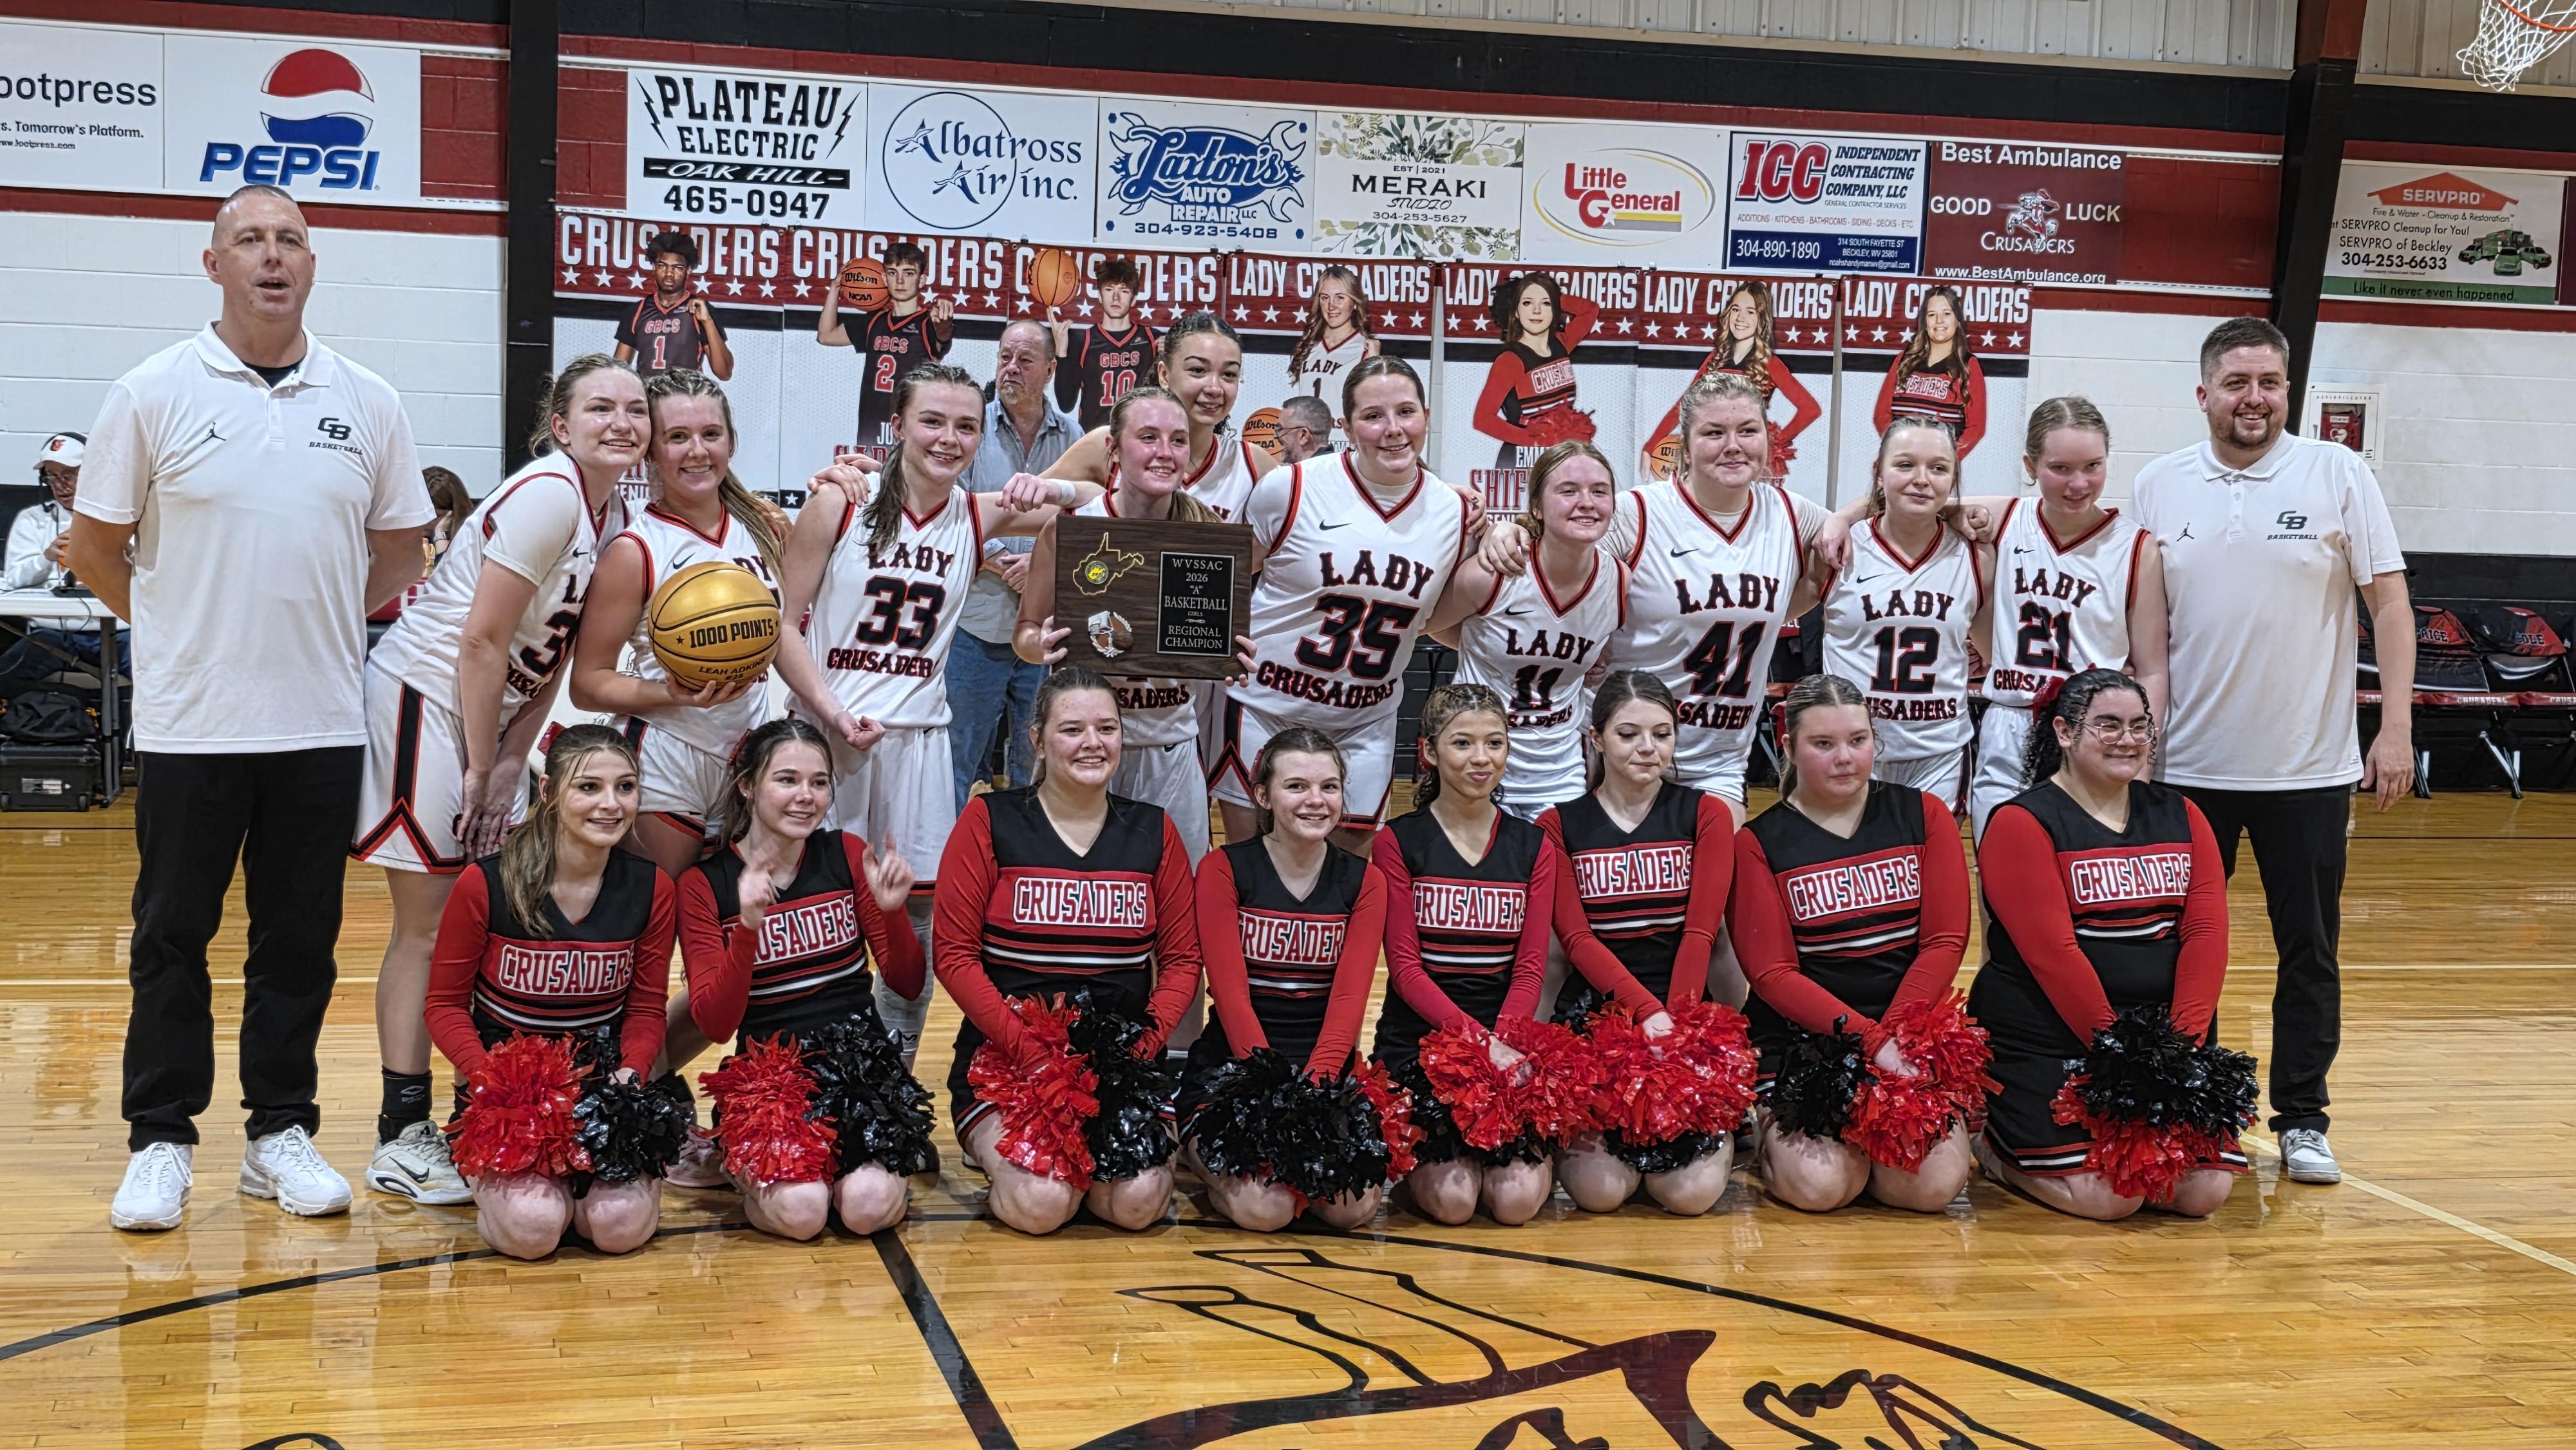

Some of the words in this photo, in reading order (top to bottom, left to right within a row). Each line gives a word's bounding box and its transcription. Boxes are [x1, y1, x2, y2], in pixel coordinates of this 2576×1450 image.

[655, 75, 842, 129] PLATEAU
[15, 120, 86, 135] Tomorrow's
[89, 125, 144, 138] Platform.
[677, 126, 819, 161] ELECTRIC
[895, 118, 1082, 164] Albatross
[200, 142, 380, 191] PEPSI
[1119, 125, 1286, 204] Laxton's
[1835, 146, 1921, 162] INDEPENDENT
[1941, 142, 1992, 164] Best
[1997, 144, 2122, 170] Ambulance
[933, 160, 1007, 205] Air
[1352, 174, 1486, 198] MERAKI
[1564, 162, 1627, 200] Little
[1735, 139, 1832, 205] ICC
[1830, 164, 1915, 180] CONTRACTING
[663, 185, 830, 220] 465-0947
[1180, 186, 1232, 204] AUTO
[1386, 198, 1453, 211] STUDIO
[1825, 183, 1884, 200] COMPANY,
[1886, 185, 1908, 199] LLC
[2403, 188, 2480, 205] SERVPRO
[1172, 204, 1241, 224] REPAIR
[1242, 210, 1257, 219] LLC
[1372, 211, 1467, 223] 304-253-5627
[1578, 189, 1681, 229] General
[1738, 214, 1770, 223] ADDITIONS
[1930, 195, 1991, 216] GOOD
[2065, 203, 2121, 222] LUCK
[2372, 207, 2387, 216] Fire
[2427, 211, 2459, 221] Cleanup
[1135, 222, 1278, 239] 304-923-5408
[1837, 238, 1848, 246] 314
[1849, 238, 1869, 247] SOUTH
[1870, 239, 1895, 247] FAYETTE
[1897, 240, 1905, 248] ST
[2341, 218, 2391, 231] SERVPRO
[2394, 222, 2431, 236] Cleanup
[2434, 223, 2447, 234] for
[561, 215, 781, 279] CRUSDERS
[793, 229, 1004, 290] CRUSDERS
[1736, 239, 1820, 259] 304-890-1890
[1882, 250, 1898, 258] 25801
[2339, 236, 2392, 250] SERVPRO
[2396, 238, 2409, 250] of
[2411, 240, 2453, 256] Beckley
[2341, 252, 2447, 270] 304-253-6633
[844, 272, 878, 285] Wilson
[1231, 257, 1287, 297] LADY
[1297, 262, 1430, 303] CADERS
[1444, 268, 1500, 306] LADY
[1935, 266, 2106, 285] www.BestAmbulance.org
[2354, 281, 2375, 294] Like
[2380, 283, 2386, 294] it
[2391, 287, 2422, 297] never
[2425, 288, 2453, 298] even
[848, 292, 873, 301] NCAA
[1643, 276, 1700, 315] LADY
[1844, 280, 1897, 318] LADY
[1904, 283, 2029, 323] CADERS
[652, 335, 666, 369] 1
[1099, 350, 1141, 368] GBCS
[1302, 360, 1343, 375] LADY
[875, 354, 897, 392] 2
[1099, 370, 1137, 406] 10
[309, 441, 363, 455] BASKETBALL
[1515, 446, 1551, 468] EMM
[867, 541, 954, 578] LADY
[1172, 558, 1224, 571] WVSSAC
[1319, 549, 1435, 600] LADY
[1186, 572, 1209, 583] 2026
[1674, 572, 1780, 615] LADY
[2014, 567, 2097, 608] LADY
[855, 574, 947, 652] 33
[1164, 595, 1227, 611] BASKETBALL
[1861, 589, 1955, 622] LADY
[689, 625, 728, 649] 1000
[730, 618, 774, 642] POINTS
[1164, 637, 1223, 650] CHAMPION
[1168, 625, 1222, 637] REGIONAL
[1294, 592, 1420, 681] 35
[1506, 628, 1595, 665] LADY
[2014, 599, 2076, 673] 21
[699, 666, 729, 675] LEAH
[731, 657, 766, 674] ADKINS
[1682, 621, 1767, 699] 41
[1870, 626, 1940, 694] 12
[1256, 660, 1398, 709] CRUSADERS
[1508, 664, 1565, 711] 11
[1866, 696, 1958, 722] USADERS
[1787, 854, 1921, 921] CRUSADERS
[2070, 852, 2191, 905] CRUSADERS
[1013, 876, 1147, 928] CRUSADERS
[1414, 881, 1527, 932] CRUSADER
[754, 894, 858, 965] USADERS
[1238, 910, 1347, 965] RUSADER
[499, 944, 634, 995] CRUSADERS
